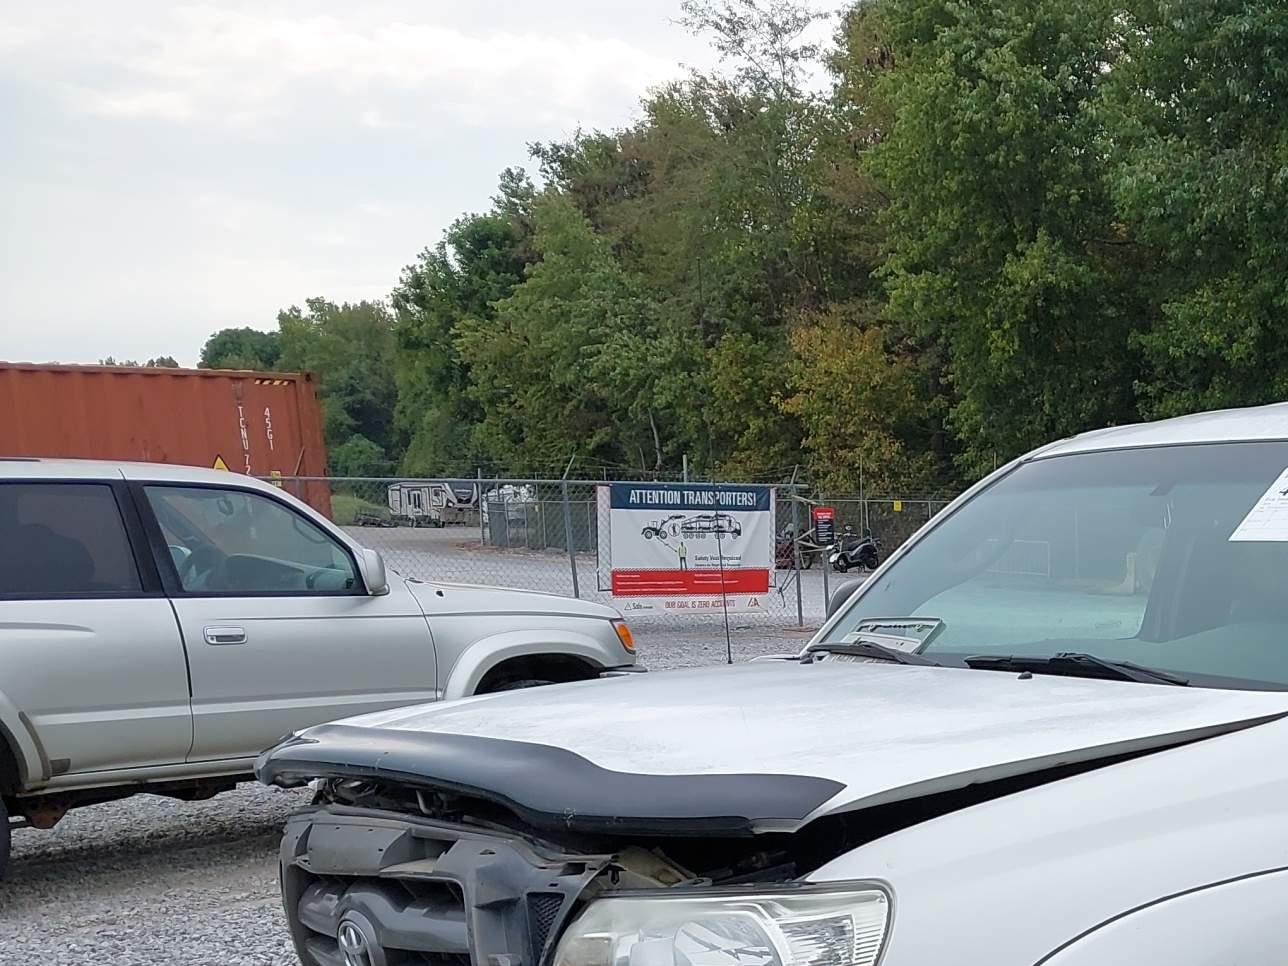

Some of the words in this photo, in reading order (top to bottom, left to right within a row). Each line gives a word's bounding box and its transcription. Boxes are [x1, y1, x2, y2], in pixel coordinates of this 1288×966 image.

[238, 406, 249, 450] TCNU
[264, 407, 274, 451] 45G1
[629, 489, 681, 505] ATTENTION
[665, 601, 676, 609] OUR
[677, 601, 690, 609] GOAL
[691, 601, 697, 609] IS
[697, 600, 710, 609] ZERO
